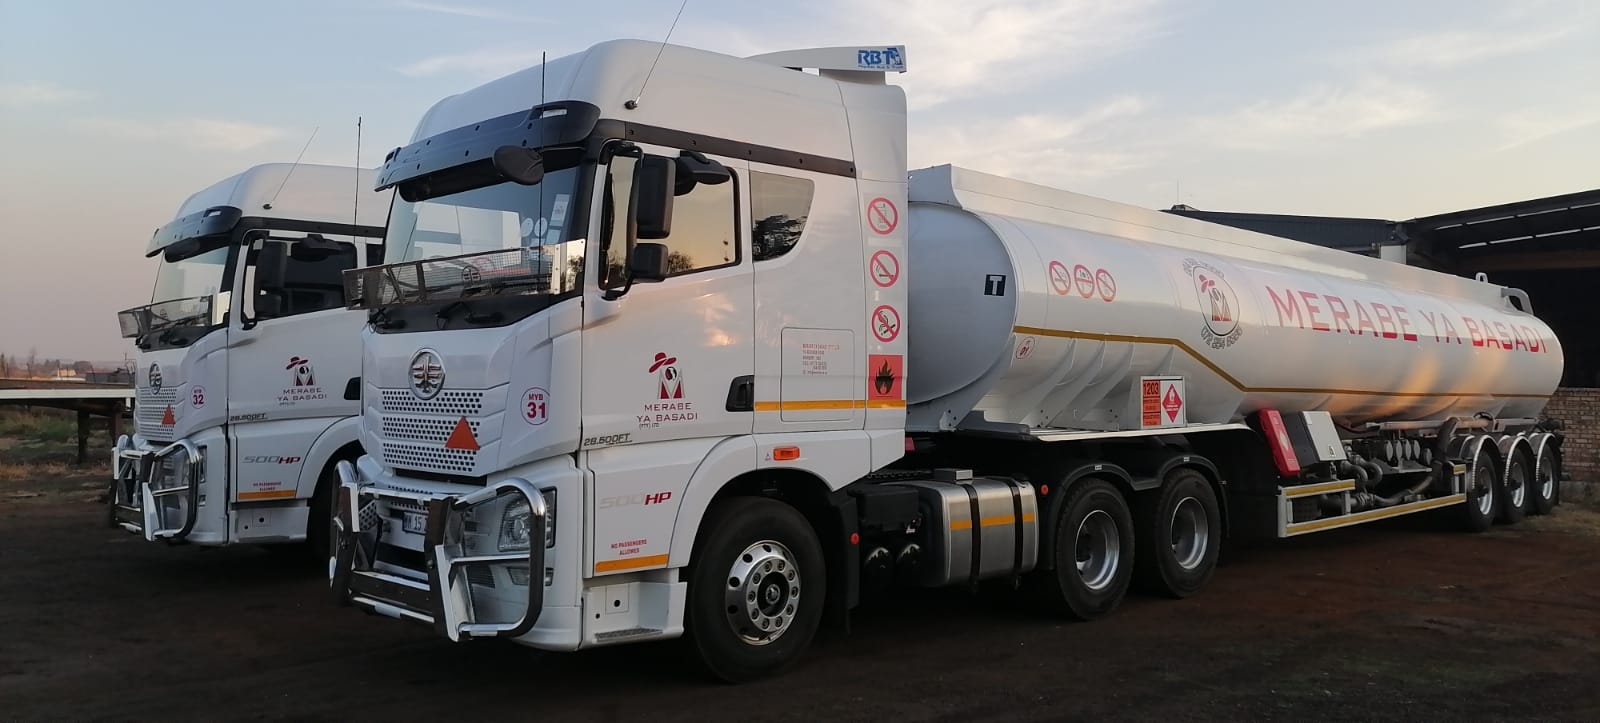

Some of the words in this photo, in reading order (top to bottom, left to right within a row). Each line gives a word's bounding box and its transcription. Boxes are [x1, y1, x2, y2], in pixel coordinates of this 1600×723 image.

[989, 275, 1003, 295] T
[1265, 285, 1418, 342] MERABE
[1418, 309, 1462, 344] YA
[1461, 316, 1548, 353] BASADI
[283, 387, 322, 395] MERABE
[1143, 382, 1159, 395] 1203
[192, 394, 205, 405] 32
[292, 393, 328, 401] BASADI
[528, 393, 544, 401] MYB
[527, 401, 546, 419] 31
[644, 402, 692, 412] MERABE
[636, 415, 652, 423] YA
[655, 412, 698, 422] BASADI
